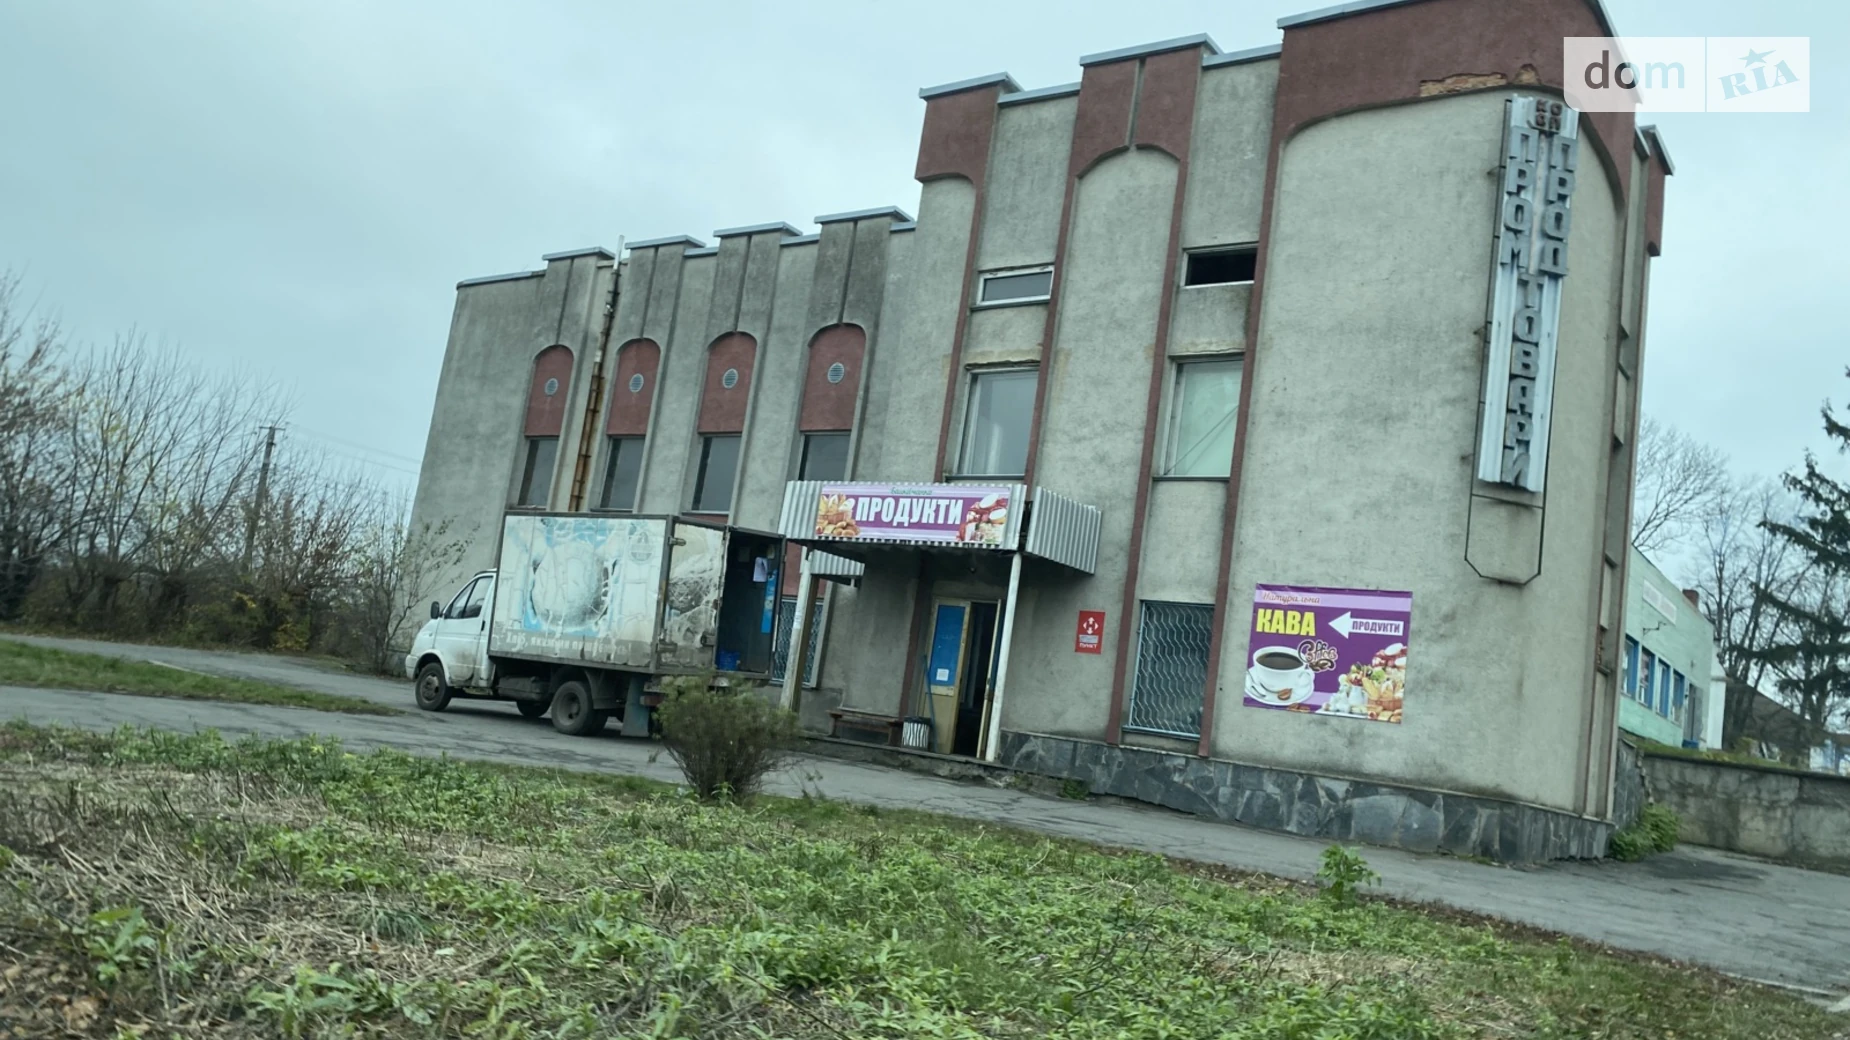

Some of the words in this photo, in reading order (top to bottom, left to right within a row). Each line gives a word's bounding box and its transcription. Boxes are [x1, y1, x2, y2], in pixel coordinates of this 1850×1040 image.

[856, 497, 963, 526] ПРОДУКТИ
[1256, 608, 1316, 637] КАВА
[1352, 620, 1400, 633] ПРОДУКТИ
